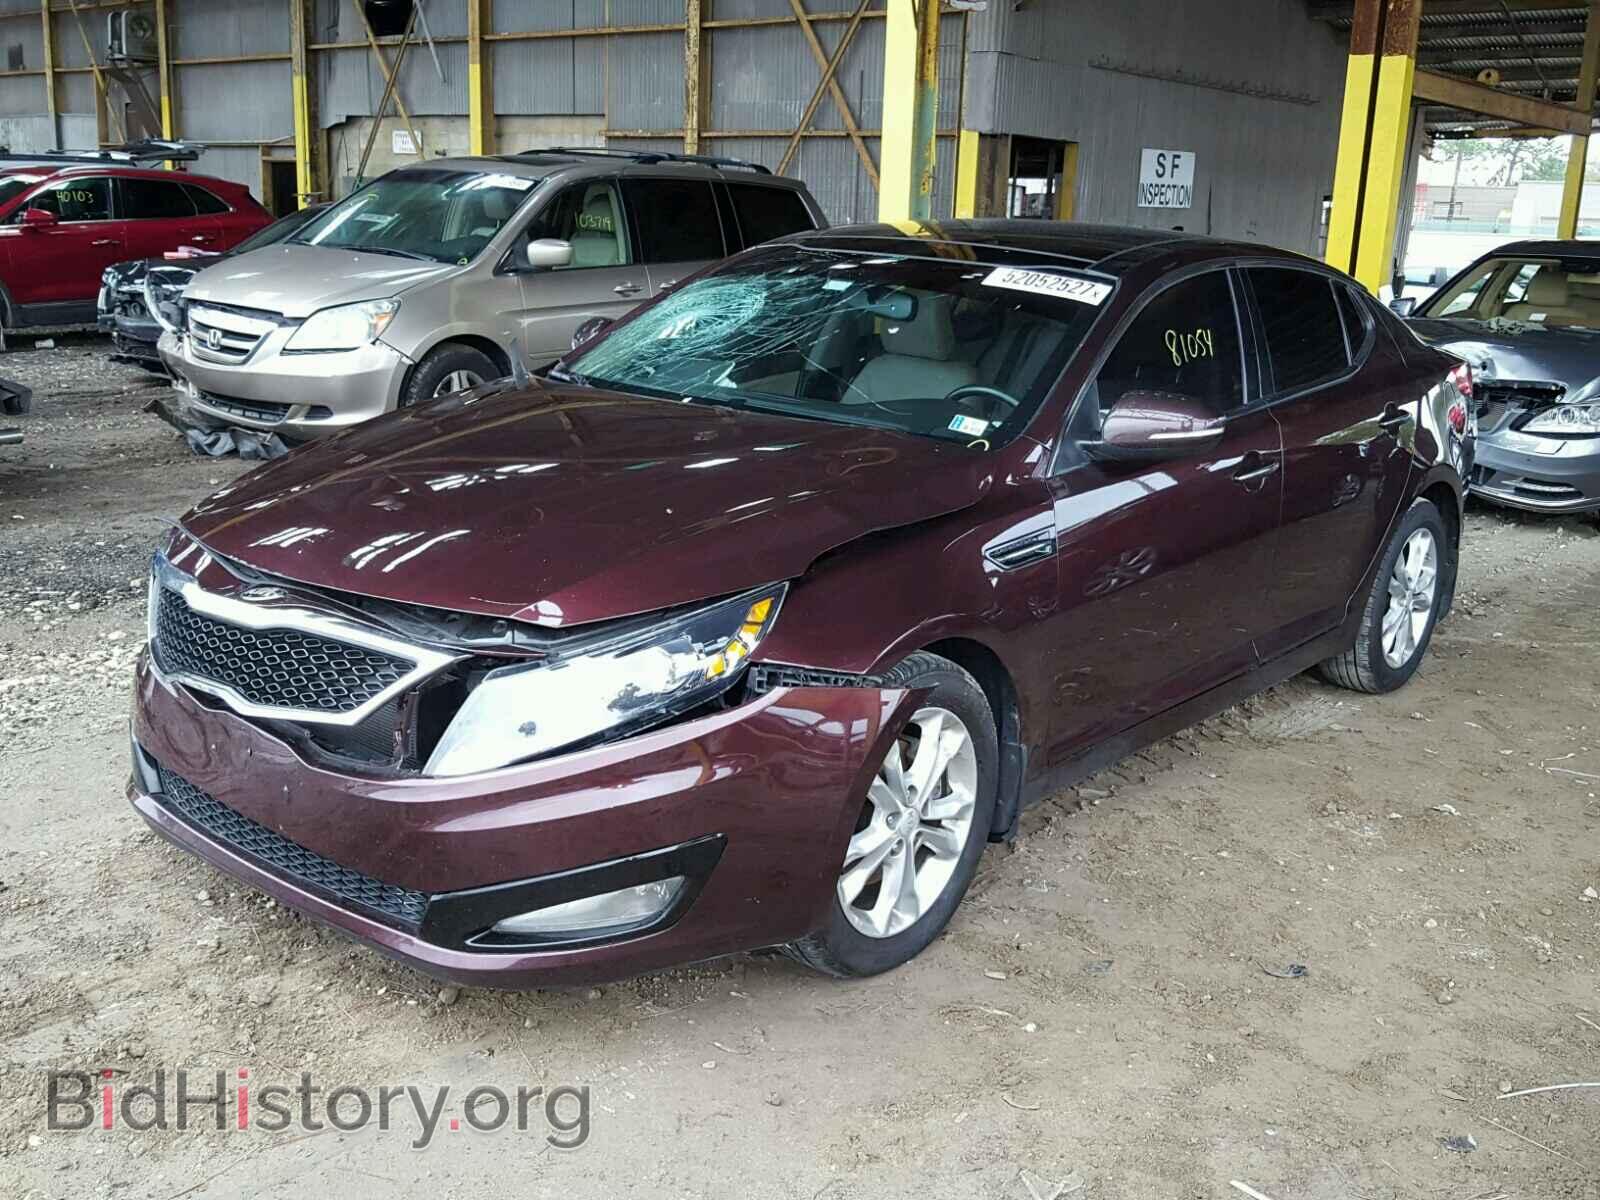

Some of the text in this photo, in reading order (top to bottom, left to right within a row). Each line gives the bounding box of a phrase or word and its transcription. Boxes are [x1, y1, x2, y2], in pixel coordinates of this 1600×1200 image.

[56, 190, 94, 204] 40103
[1138, 183, 1192, 206] INSPECTION
[1165, 328, 1214, 367] 81054
